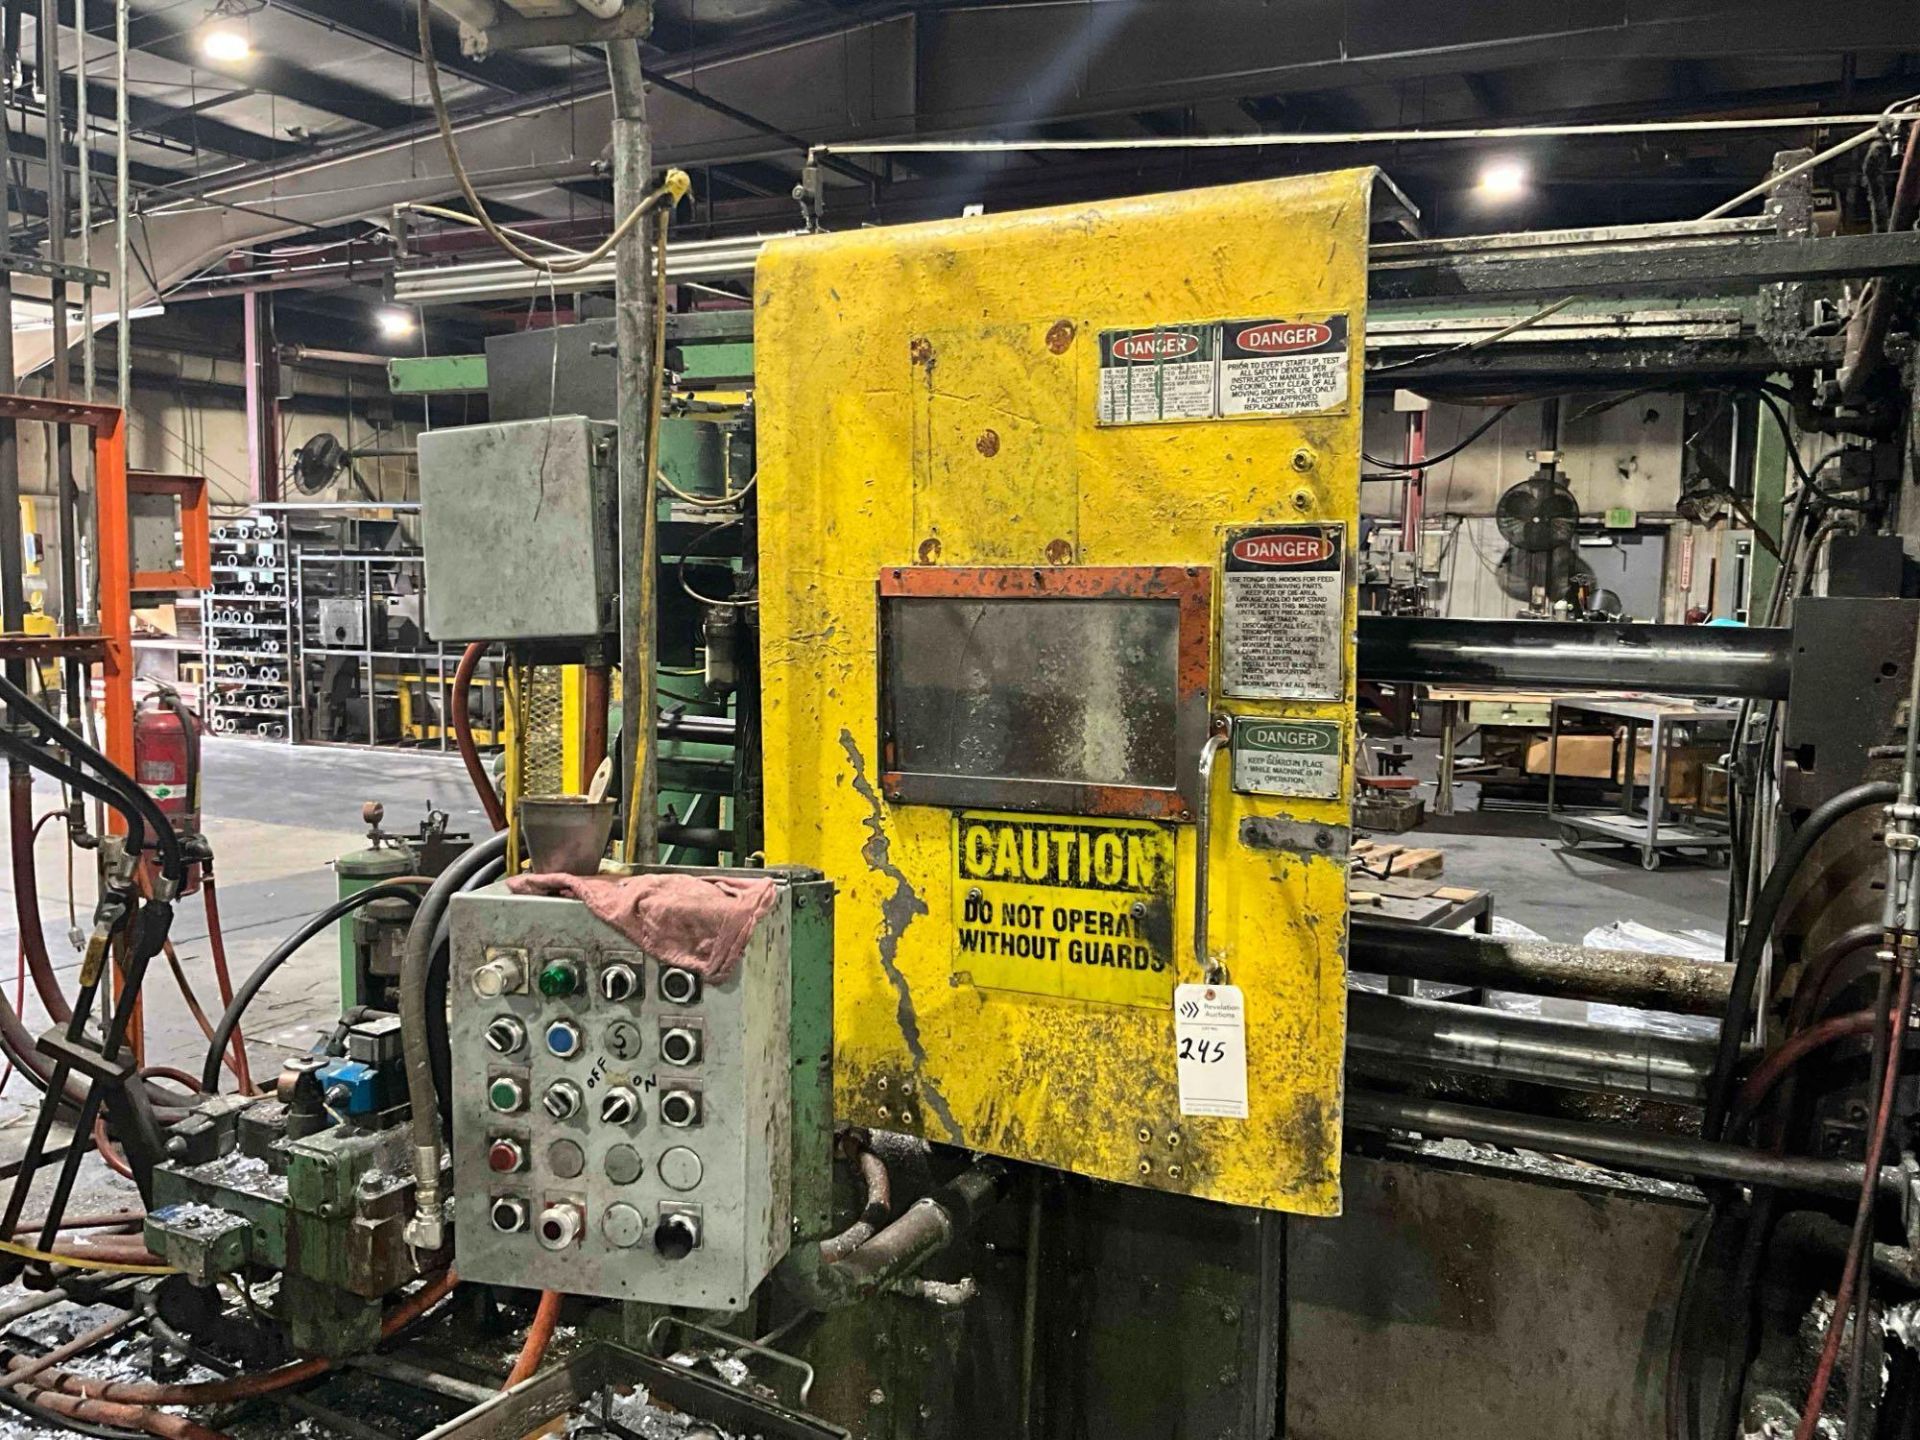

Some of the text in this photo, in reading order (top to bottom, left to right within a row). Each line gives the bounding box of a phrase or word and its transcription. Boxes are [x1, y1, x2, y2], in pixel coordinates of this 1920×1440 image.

[1124, 338, 1186, 355] DANGER
[1250, 330, 1317, 347] DANGER
[1228, 362, 1248, 370] PRIOR
[1245, 402, 1294, 410] REPLACEMENT
[1246, 542, 1318, 557] DANGER
[1258, 731, 1317, 745] DANGER
[1273, 767, 1304, 775] MACHINE
[1302, 760, 1324, 768] PLACE
[966, 825, 1154, 886] CAUTION
[964, 898, 1147, 938] DO NOT OPERAT
[959, 928, 1165, 972] WITHOUT GUARDS
[1204, 1003, 1240, 1011] Revelation
[1179, 1037, 1226, 1063] 245
[587, 1056, 607, 1088] OFF
[633, 1074, 656, 1093] ON
